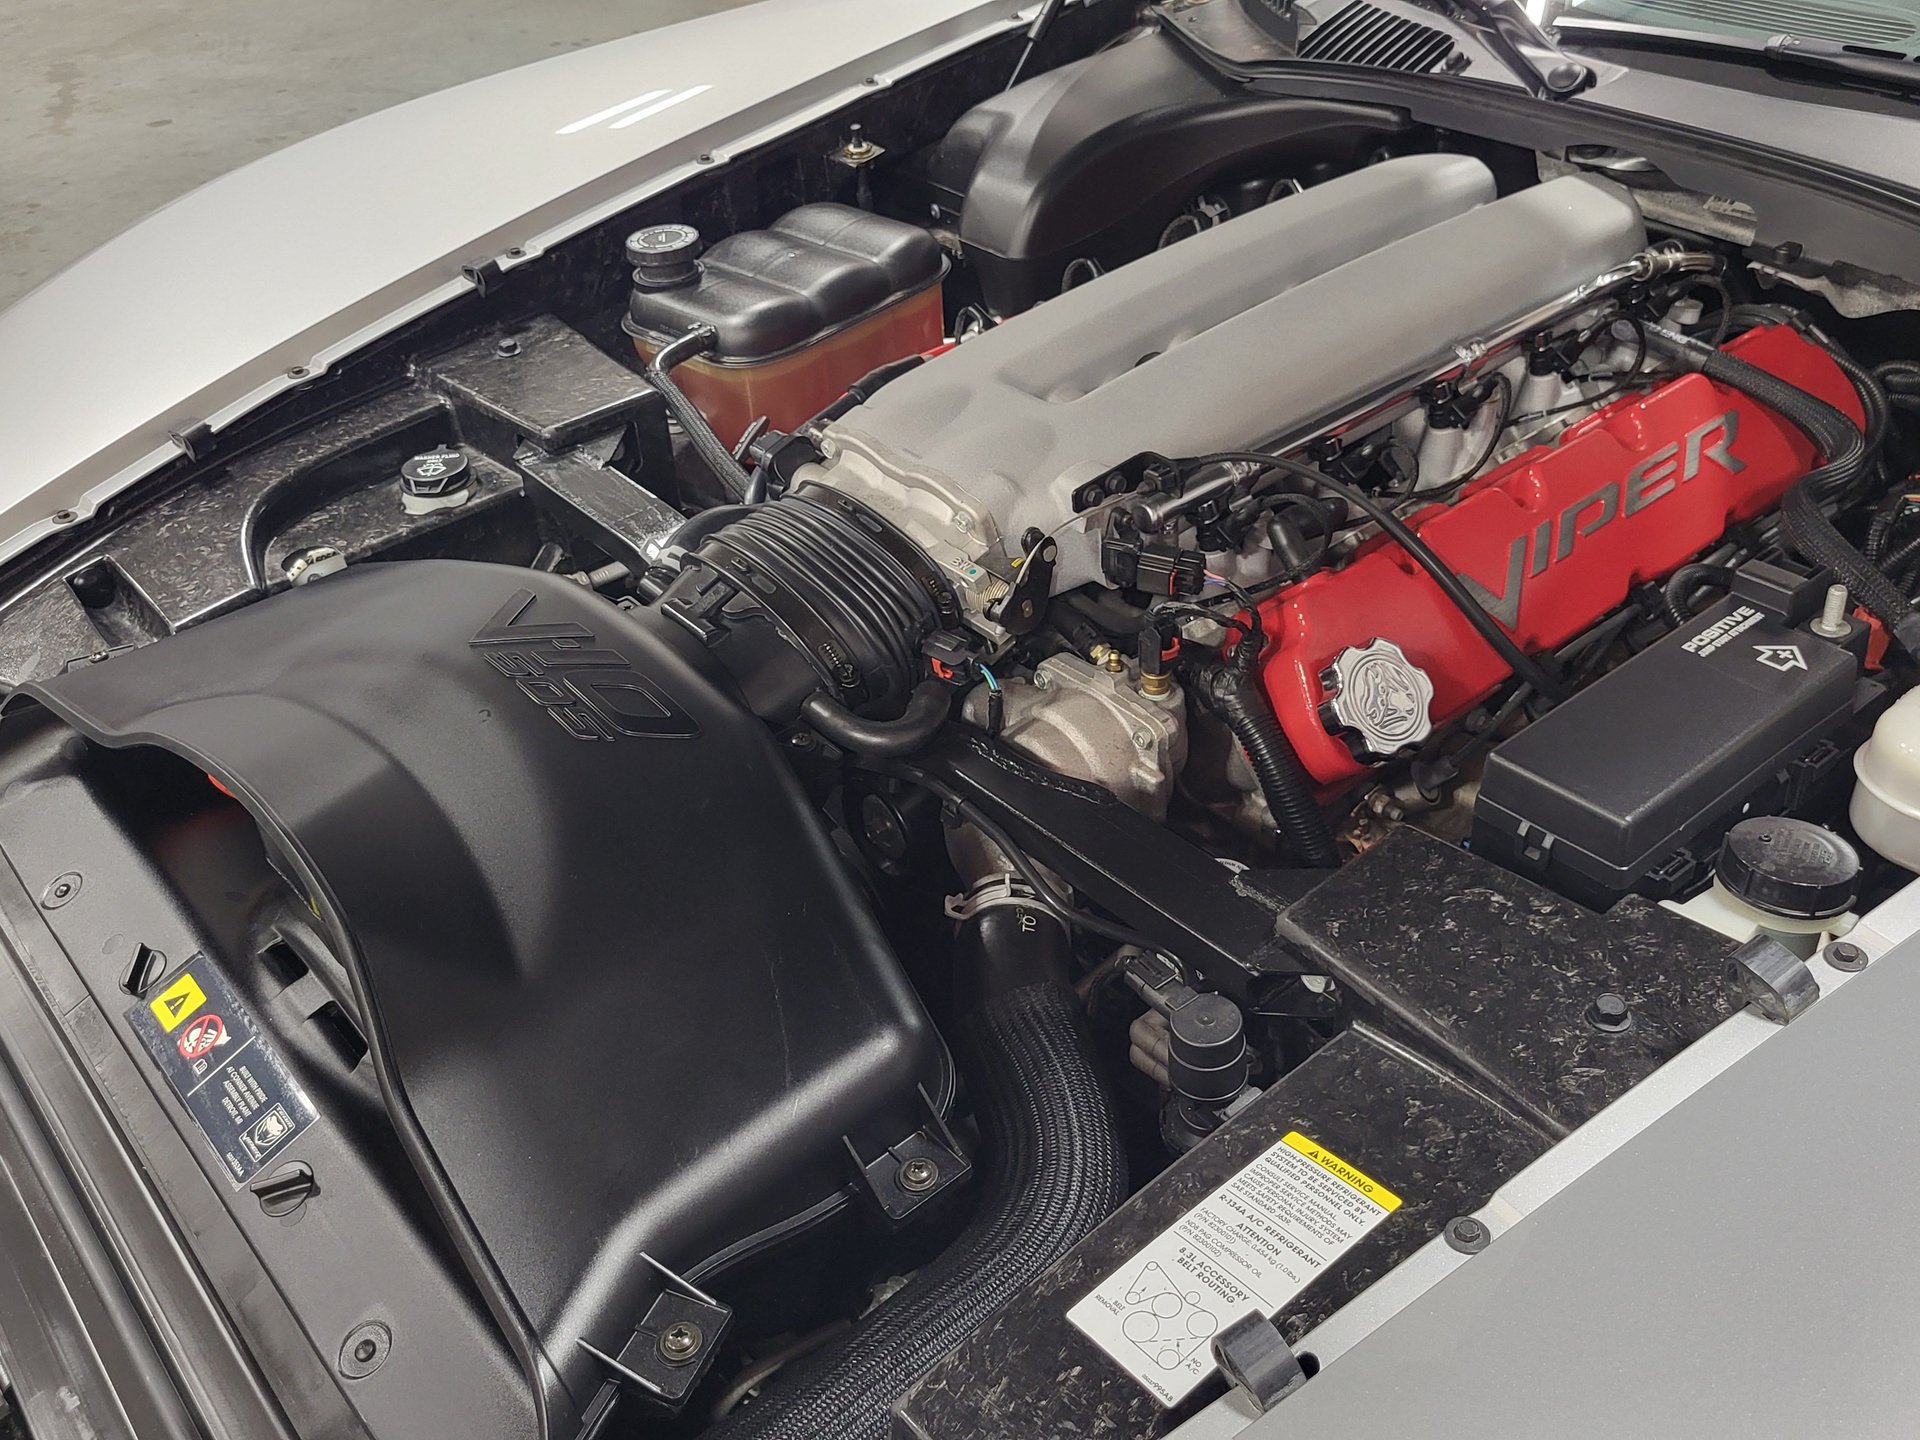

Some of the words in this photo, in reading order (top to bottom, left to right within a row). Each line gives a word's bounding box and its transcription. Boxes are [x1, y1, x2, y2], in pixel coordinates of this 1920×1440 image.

[1456, 409, 1747, 631] VIPER
[1681, 605, 1756, 653] POSITIVE
[483, 650, 616, 742] 505
[223, 1079, 241, 1103] ASSEMBLY
[238, 1101, 250, 1117] PLANT
[226, 1065, 233, 1073] AT
[230, 1071, 246, 1092] CONNER
[243, 1090, 259, 1109] AVENUE
[239, 1066, 250, 1079] BUILT
[247, 1077, 257, 1089] WITH
[255, 1088, 267, 1102] PRIDE
[221, 1096, 238, 1117] DETROIT,
[235, 1116, 242, 1124] MI
[242, 1133, 260, 1159] VIPER
[1254, 1162, 1284, 1183] CONSULT
[1282, 1180, 1309, 1200] SERVICE
[1264, 1155, 1301, 1182] QUALIFIED
[1299, 1179, 1343, 1210] PERSONNEL
[1341, 1208, 1366, 1226] ONLY.
[1270, 1151, 1297, 1170] SYSTEM
[1296, 1168, 1308, 1177] TO
[1307, 1174, 1318, 1183] BE
[1317, 1181, 1354, 1208] SERVICED
[1353, 1206, 1366, 1215] BY
[1277, 1145, 1331, 1183] HIGH-PRESSURE
[1330, 1180, 1381, 1216] REFRIGERANT
[1319, 1155, 1375, 1194] WARNING
[1231, 1181, 1244, 1192] SAE
[1242, 1189, 1276, 1214] STANDARD
[1274, 1212, 1293, 1226] J639.
[1237, 1176, 1257, 1192] MEETS
[1255, 1189, 1279, 1206] SAFETY
[1276, 1204, 1324, 1238] REQUIREMENTS
[1322, 1236, 1334, 1246] OF
[1243, 1172, 1265, 1188] CAUSE
[1263, 1185, 1296, 1209] PERSONAL
[1318, 1224, 1344, 1243] SYSTEM
[1249, 1167, 1280, 1190] IMPROPER
[1278, 1187, 1306, 1207] SERVICE
[1304, 1205, 1336, 1228] METHODS
[1334, 1226, 1352, 1240] MAY
[1177, 1223, 1194, 1237] (P/N
[1191, 1233, 1222, 1257] 82300102)
[1192, 1211, 1209, 1224] (P/N
[1205, 1220, 1237, 1245] 82300101)
[1200, 1206, 1227, 1228] FACTORY
[1224, 1224, 1253, 1246] CHARGE:
[1265, 1256, 1278, 1265] kg
[1218, 1193, 1247, 1215] R-134A
[1245, 1212, 1265, 1228] A/C
[1263, 1225, 1321, 1269] REFRIGERANT
[1235, 1221, 1281, 1256] ATTENTION
[1178, 1246, 1198, 1262] 8.3L
[1196, 1259, 1249, 1302] ACCESSORY
[1197, 1228, 1212, 1239] PAG
[1210, 1237, 1252, 1270] COMPRESSOR
[1250, 1267, 1263, 1278] OIL
[1176, 1256, 1197, 1274] BELT
[1195, 1271, 1236, 1304] ROUTING
[1094, 1293, 1120, 1316] REMOVAL
[1112, 1299, 1125, 1311] BELT
[1184, 1362, 1200, 1375] A/C
[1189, 1357, 1202, 1368] NO
